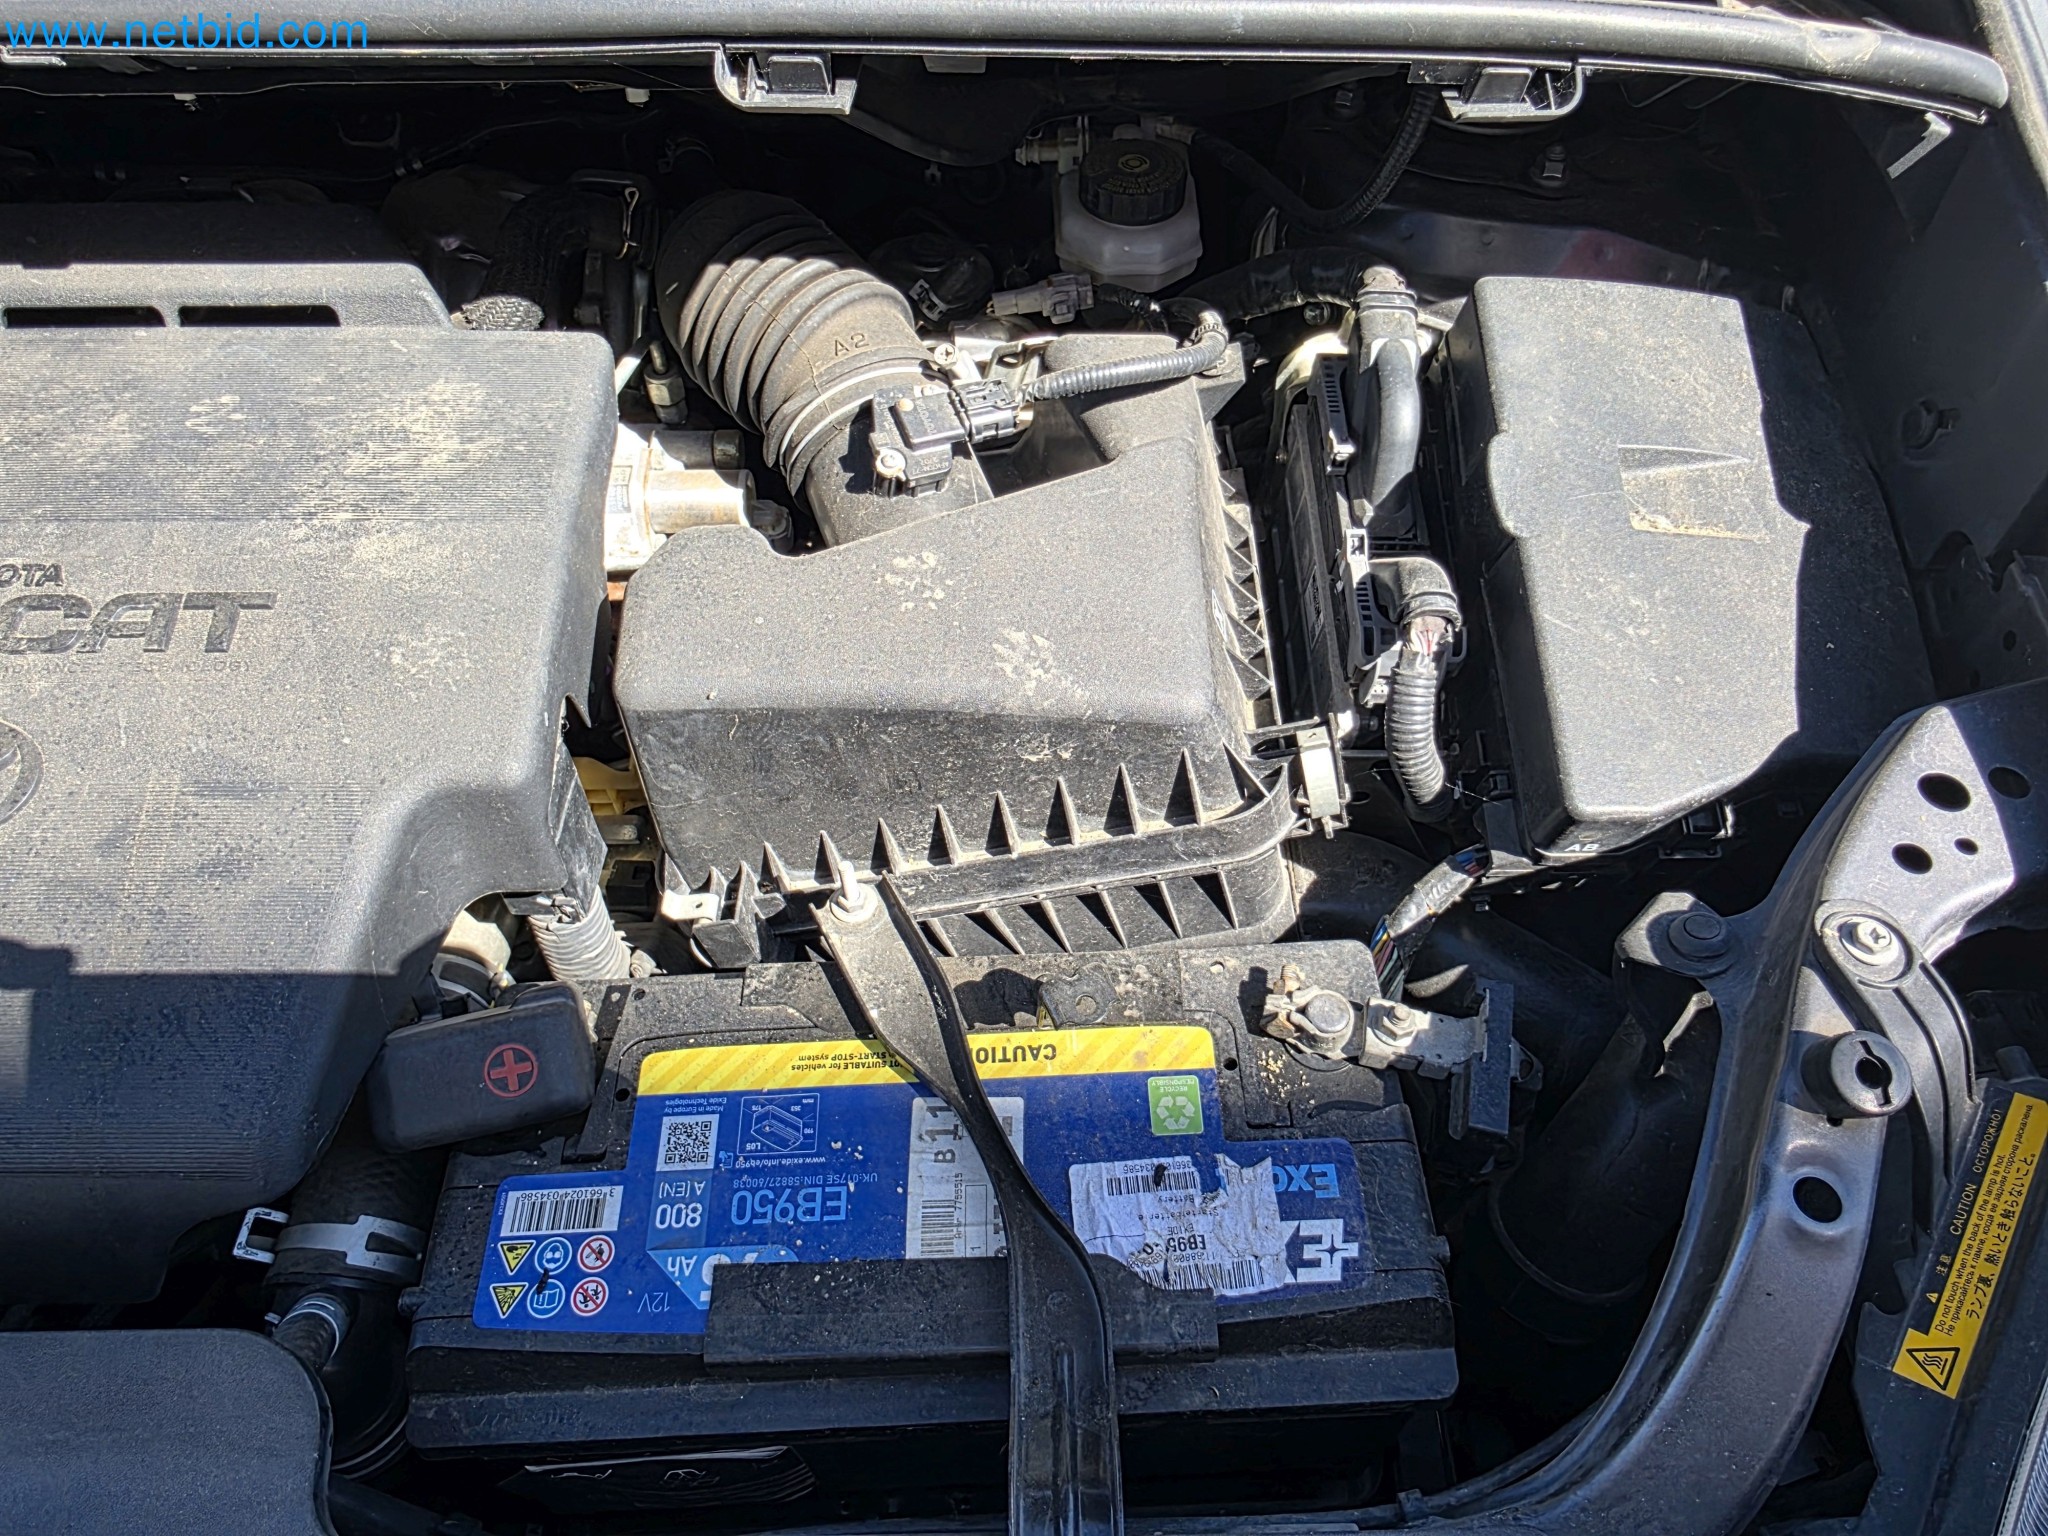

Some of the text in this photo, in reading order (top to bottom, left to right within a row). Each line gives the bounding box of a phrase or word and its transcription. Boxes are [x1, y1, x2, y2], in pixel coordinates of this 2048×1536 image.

[833, 332, 870, 357] A2
[1564, 844, 1599, 852] AB
[798, 1053, 829, 1062] system
[830, 1052, 887, 1062] START-STOP
[791, 1063, 827, 1072] vehicles
[828, 1062, 841, 1071] for
[842, 1060, 887, 1070] SUITABLE
[665, 1097, 708, 1106] Technologies
[673, 1106, 697, 1114] Europe
[746, 1142, 761, 1150] L05
[1972, 1109, 2003, 1173] ОСТОРОЖНО!
[2002, 1144, 2020, 1174] сторона
[733, 1174, 823, 1188] DIN:58827/60038
[1993, 1175, 2009, 1202] задняя
[520, 1187, 616, 1202] 3 661024 034586
[658, 1180, 705, 1198] A (EN)
[954, 1172, 963, 1212] 7755515
[731, 1185, 848, 1226] EB950
[1158, 1193, 1194, 1204] Battery
[1138, 1207, 1219, 1221] Starterbattere
[1950, 1184, 1977, 1235] CAUTION
[1989, 1202, 1998, 1212] ее
[655, 1202, 703, 1229] 800
[1167, 1222, 1194, 1236] EXIDE
[1981, 1214, 1995, 1235] когда
[1934, 1152, 2005, 1332] Do not touch when the back of the lamp is hot.
[1971, 1236, 1987, 1263] лампе,
[667, 1255, 697, 1277] Ah
[637, 1291, 670, 1313] 12V
[1950, 1270, 1976, 1322] прикасайтесь
[1944, 1324, 1955, 1336] Не
